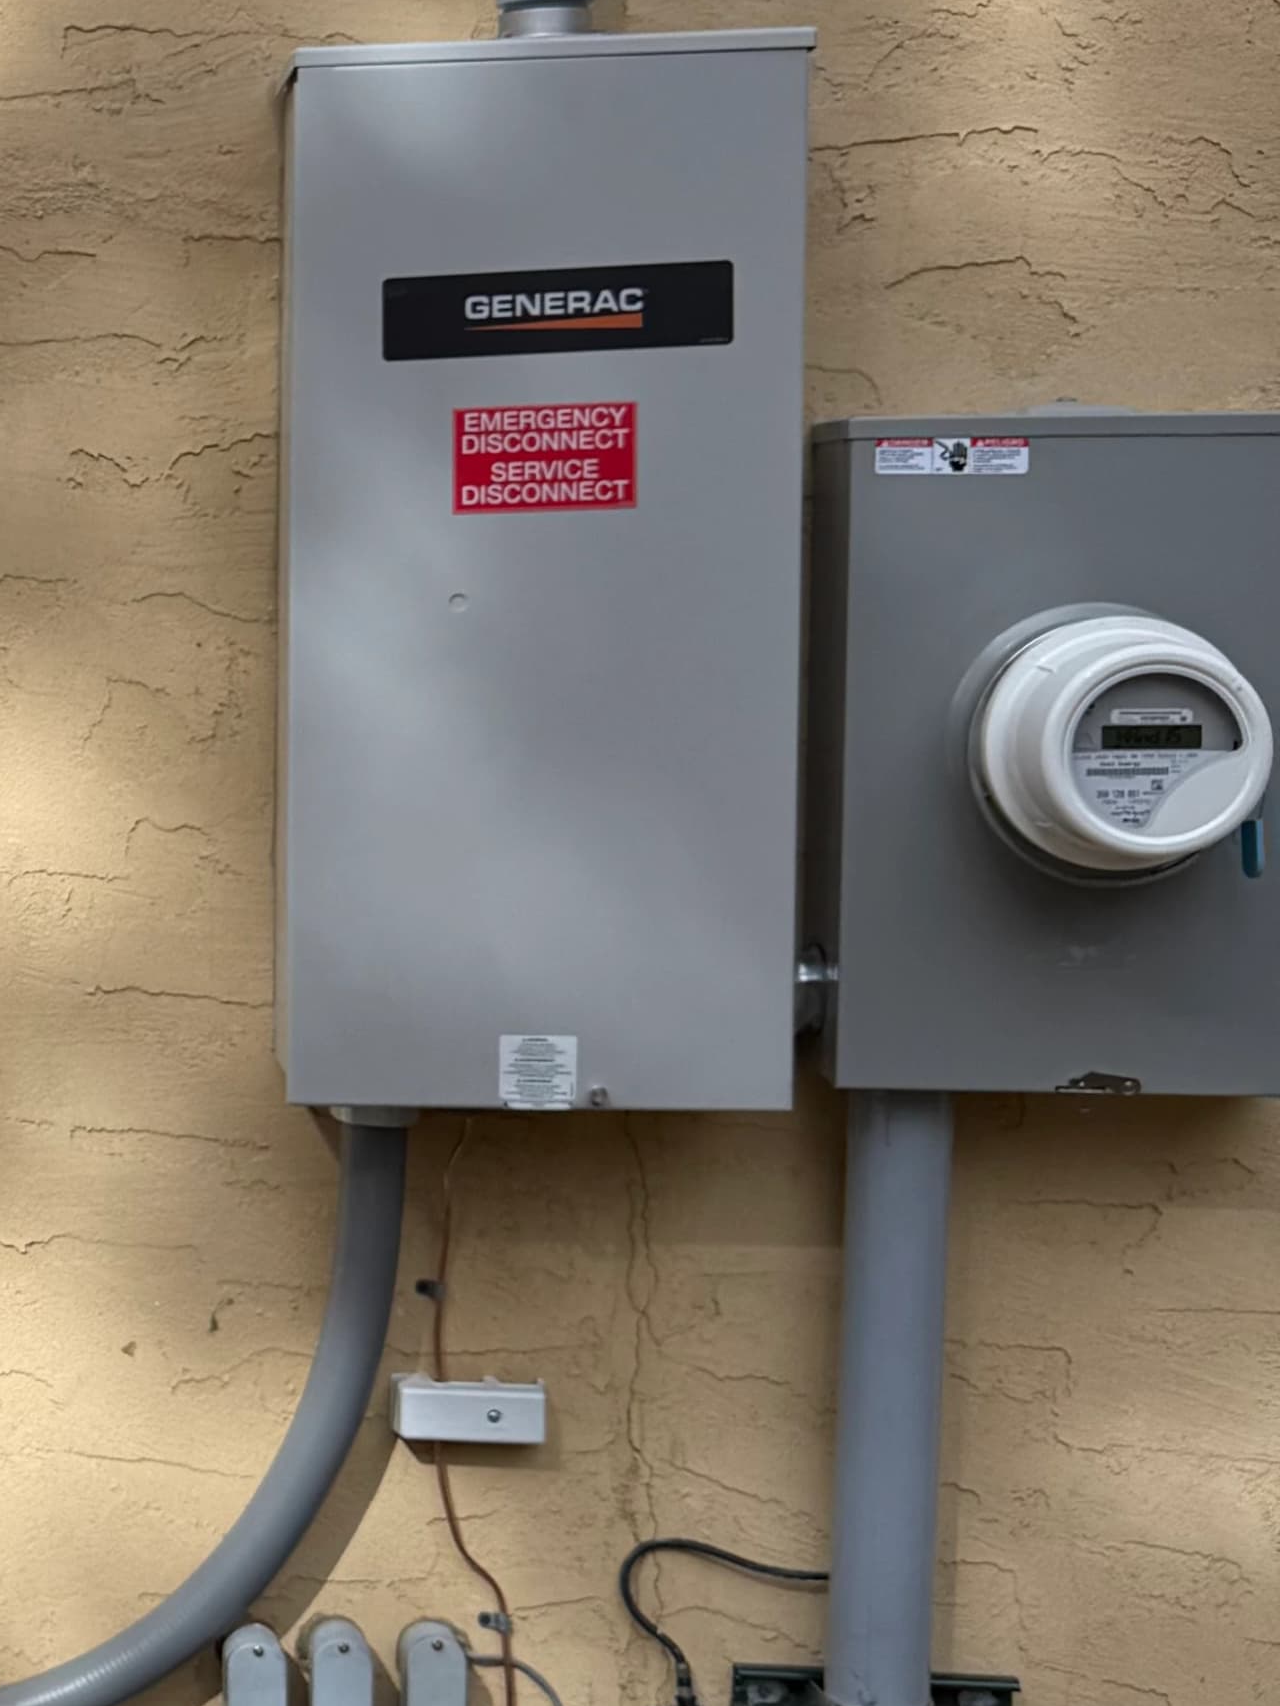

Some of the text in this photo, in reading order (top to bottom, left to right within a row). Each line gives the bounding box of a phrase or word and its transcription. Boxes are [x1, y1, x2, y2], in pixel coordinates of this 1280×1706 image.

[464, 288, 645, 320] GENERAC
[463, 406, 627, 433] EMERGENCY
[461, 428, 629, 455] DISCONNECT
[490, 459, 600, 482] SERVICE
[461, 480, 629, 506] DISCONNECT
